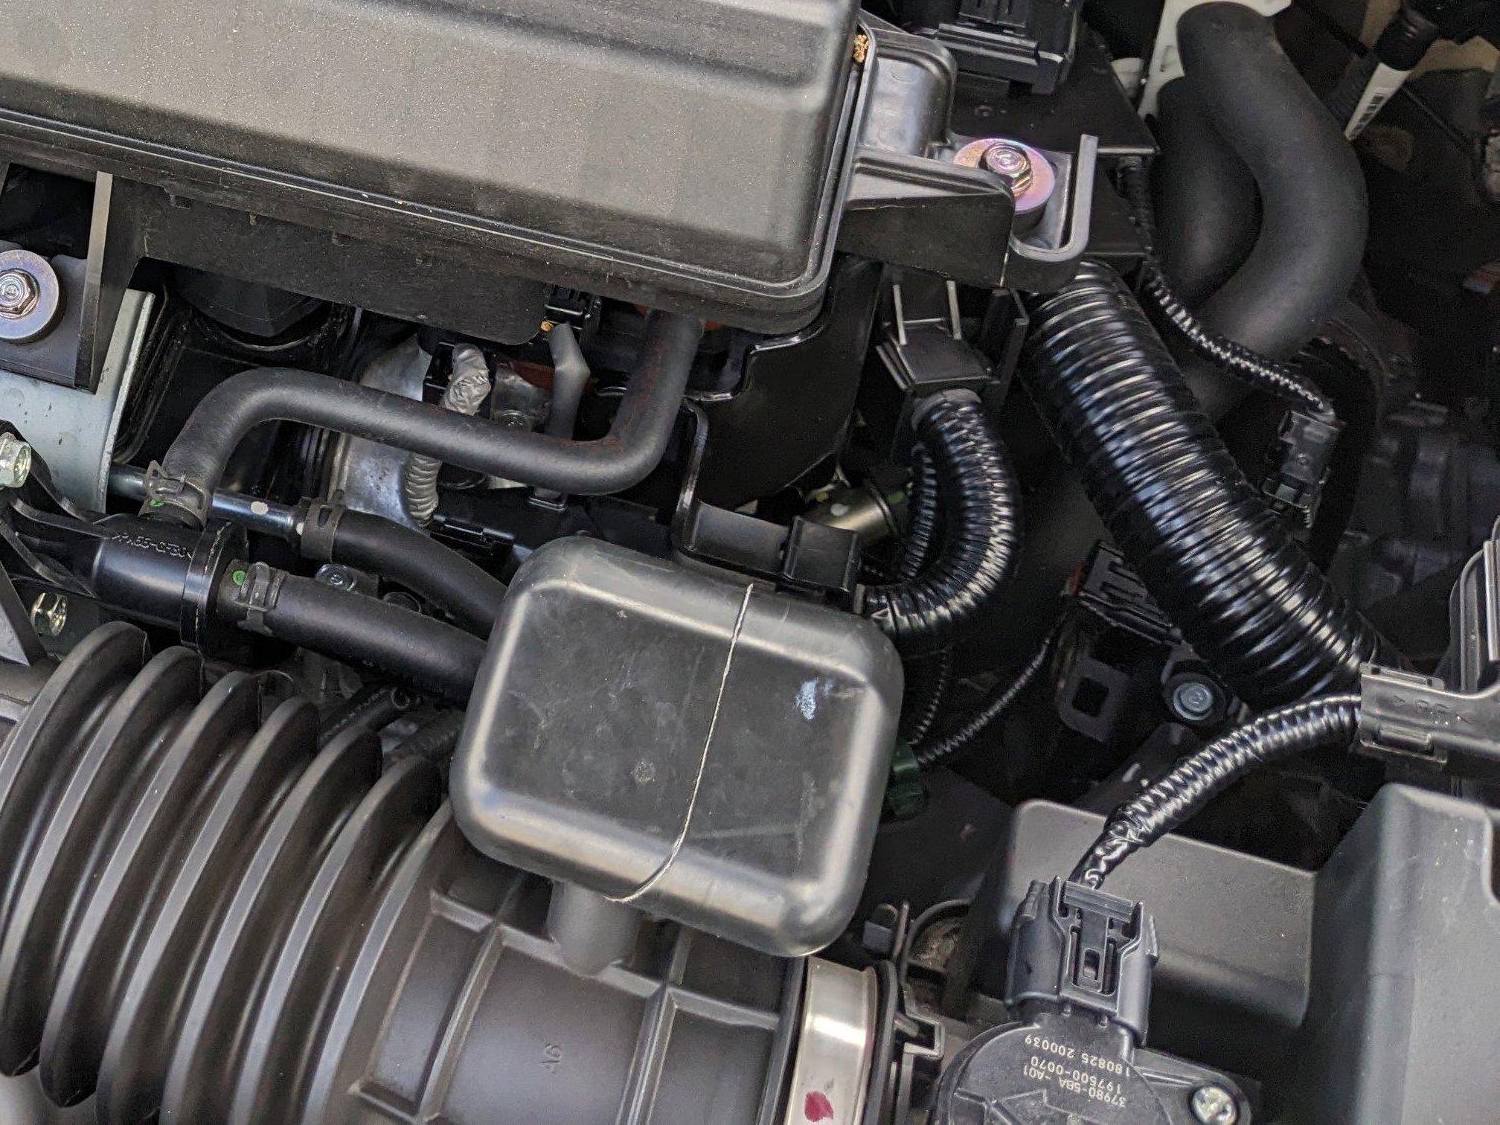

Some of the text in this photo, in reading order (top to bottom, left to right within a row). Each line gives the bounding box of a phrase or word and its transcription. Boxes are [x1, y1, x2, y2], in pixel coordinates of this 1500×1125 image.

[1024, 1033, 1131, 1078] 180825 200039
[1030, 1055, 1122, 1095] 197500-0070
